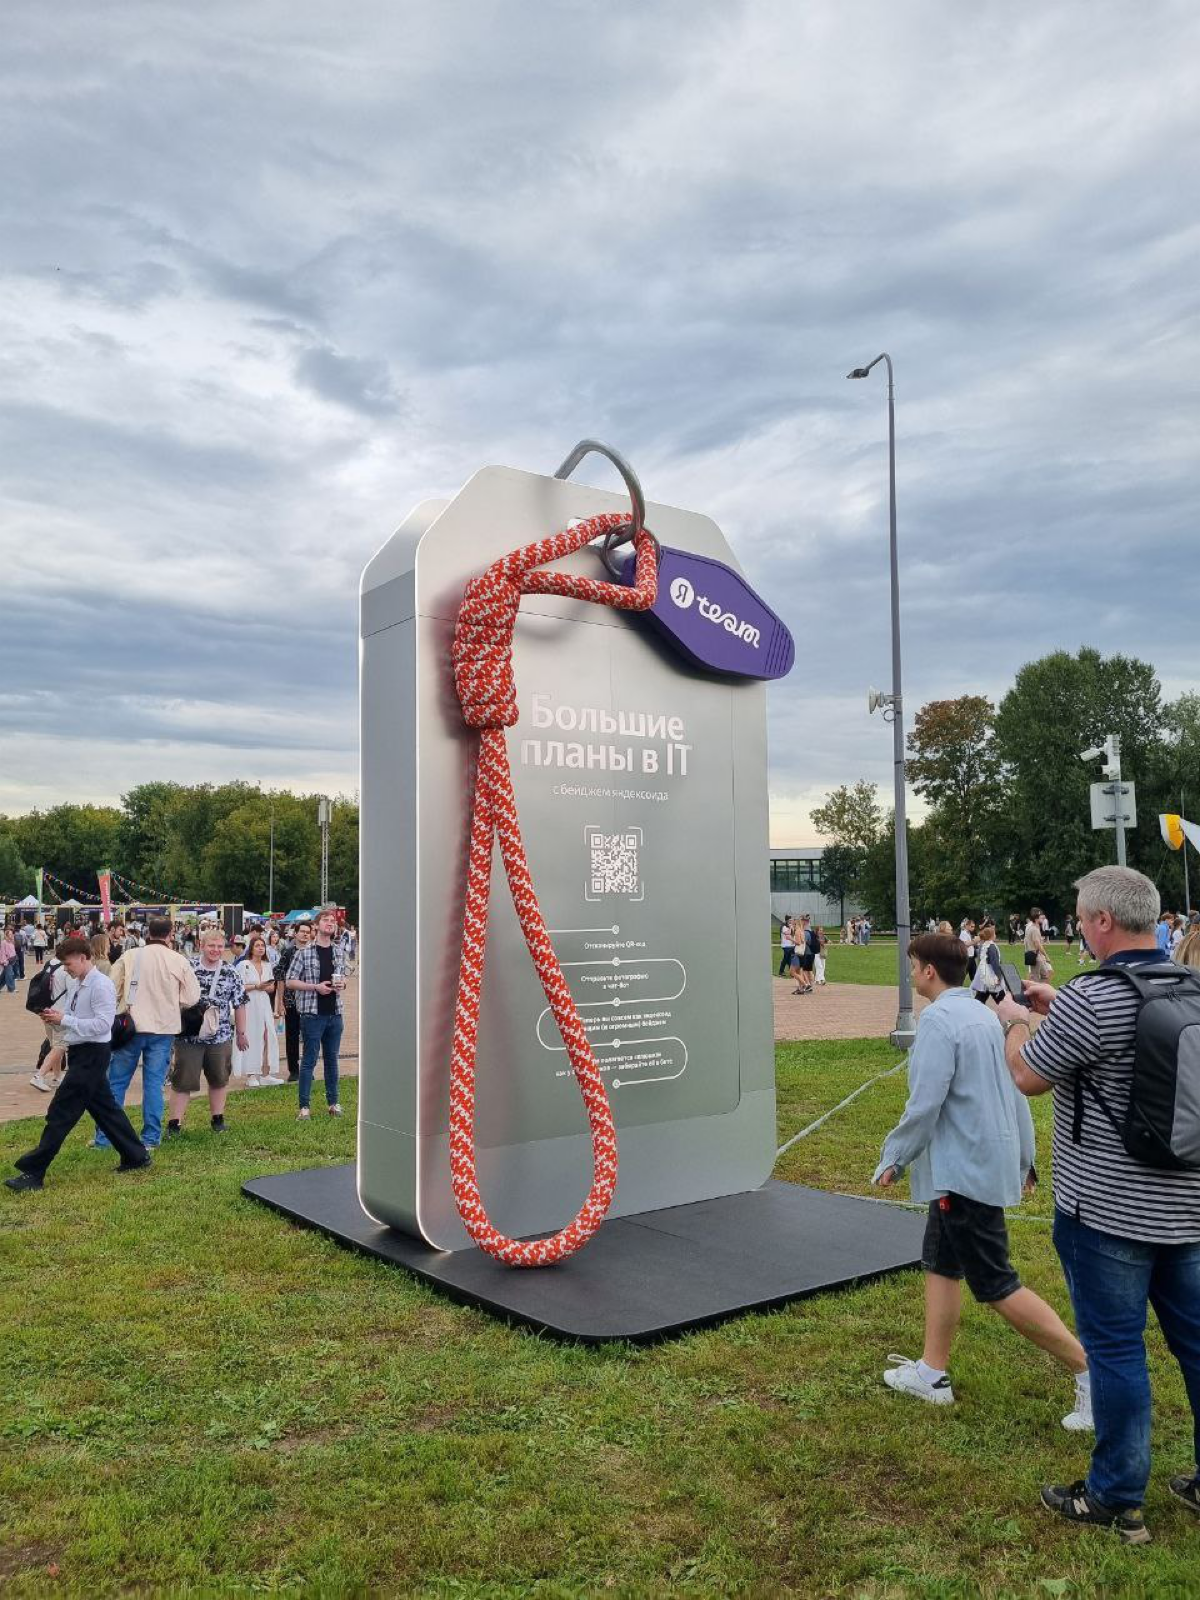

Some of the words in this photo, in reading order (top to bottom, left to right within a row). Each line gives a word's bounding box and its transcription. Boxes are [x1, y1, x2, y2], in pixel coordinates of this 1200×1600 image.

[697, 596, 760, 648] team
[531, 693, 684, 741] Большие
[520, 739, 634, 772] планы
[642, 749, 659, 773] в
[666, 743, 693, 776] IT
[560, 783, 610, 798] бейджем
